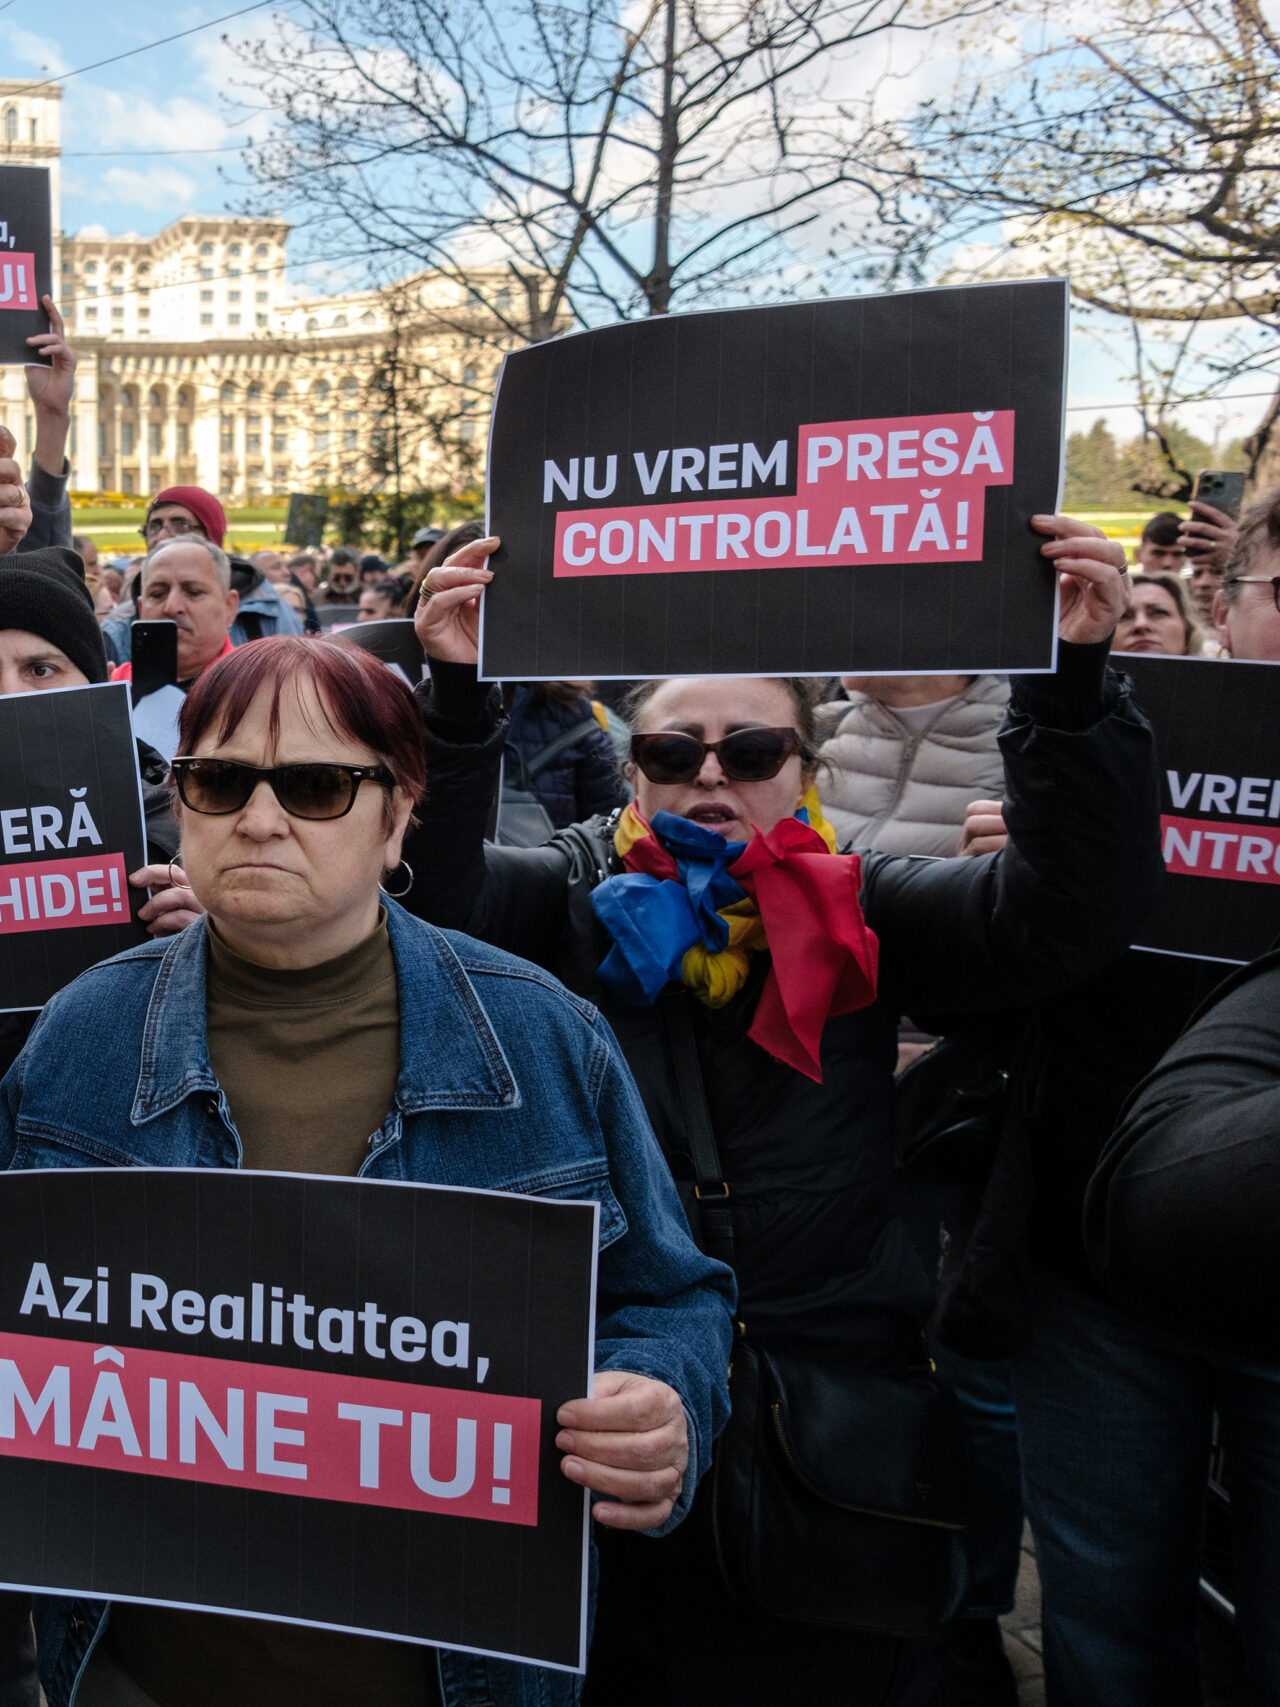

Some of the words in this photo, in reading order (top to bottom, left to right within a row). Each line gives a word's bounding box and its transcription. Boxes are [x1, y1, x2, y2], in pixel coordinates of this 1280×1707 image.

[544, 455, 617, 503] NU
[634, 440, 787, 495] VREM
[807, 413, 1003, 483] PRESĂ
[562, 489, 968, 565] CONTROLATĂ!
[1162, 827, 1280, 874] NTR
[20, 1262, 108, 1323] Azi
[131, 1273, 489, 1383] Realitatea,
[0, 1346, 307, 1479] MÂINE
[338, 1403, 512, 1504] TU!
